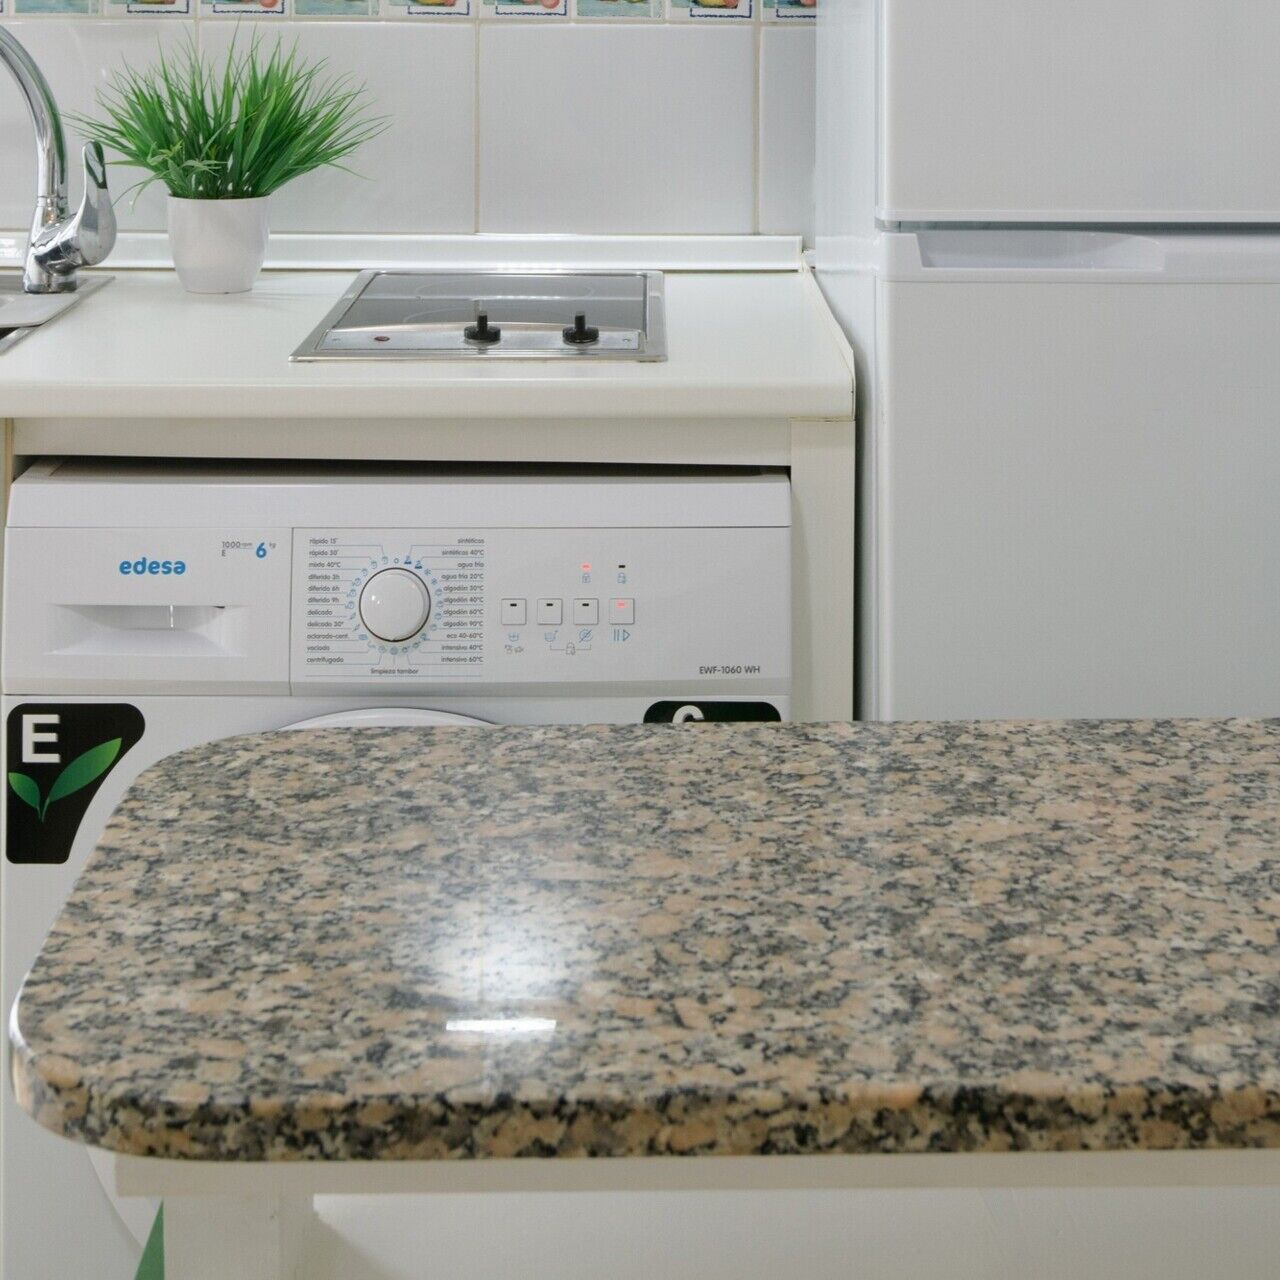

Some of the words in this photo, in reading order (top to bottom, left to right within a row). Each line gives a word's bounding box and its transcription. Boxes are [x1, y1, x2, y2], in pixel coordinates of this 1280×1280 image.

[256, 542, 267, 558] 6
[119, 557, 186, 575] edesa
[699, 665, 742, 674] EWF-1060
[744, 665, 761, 674] WH
[22, 714, 61, 763] E
